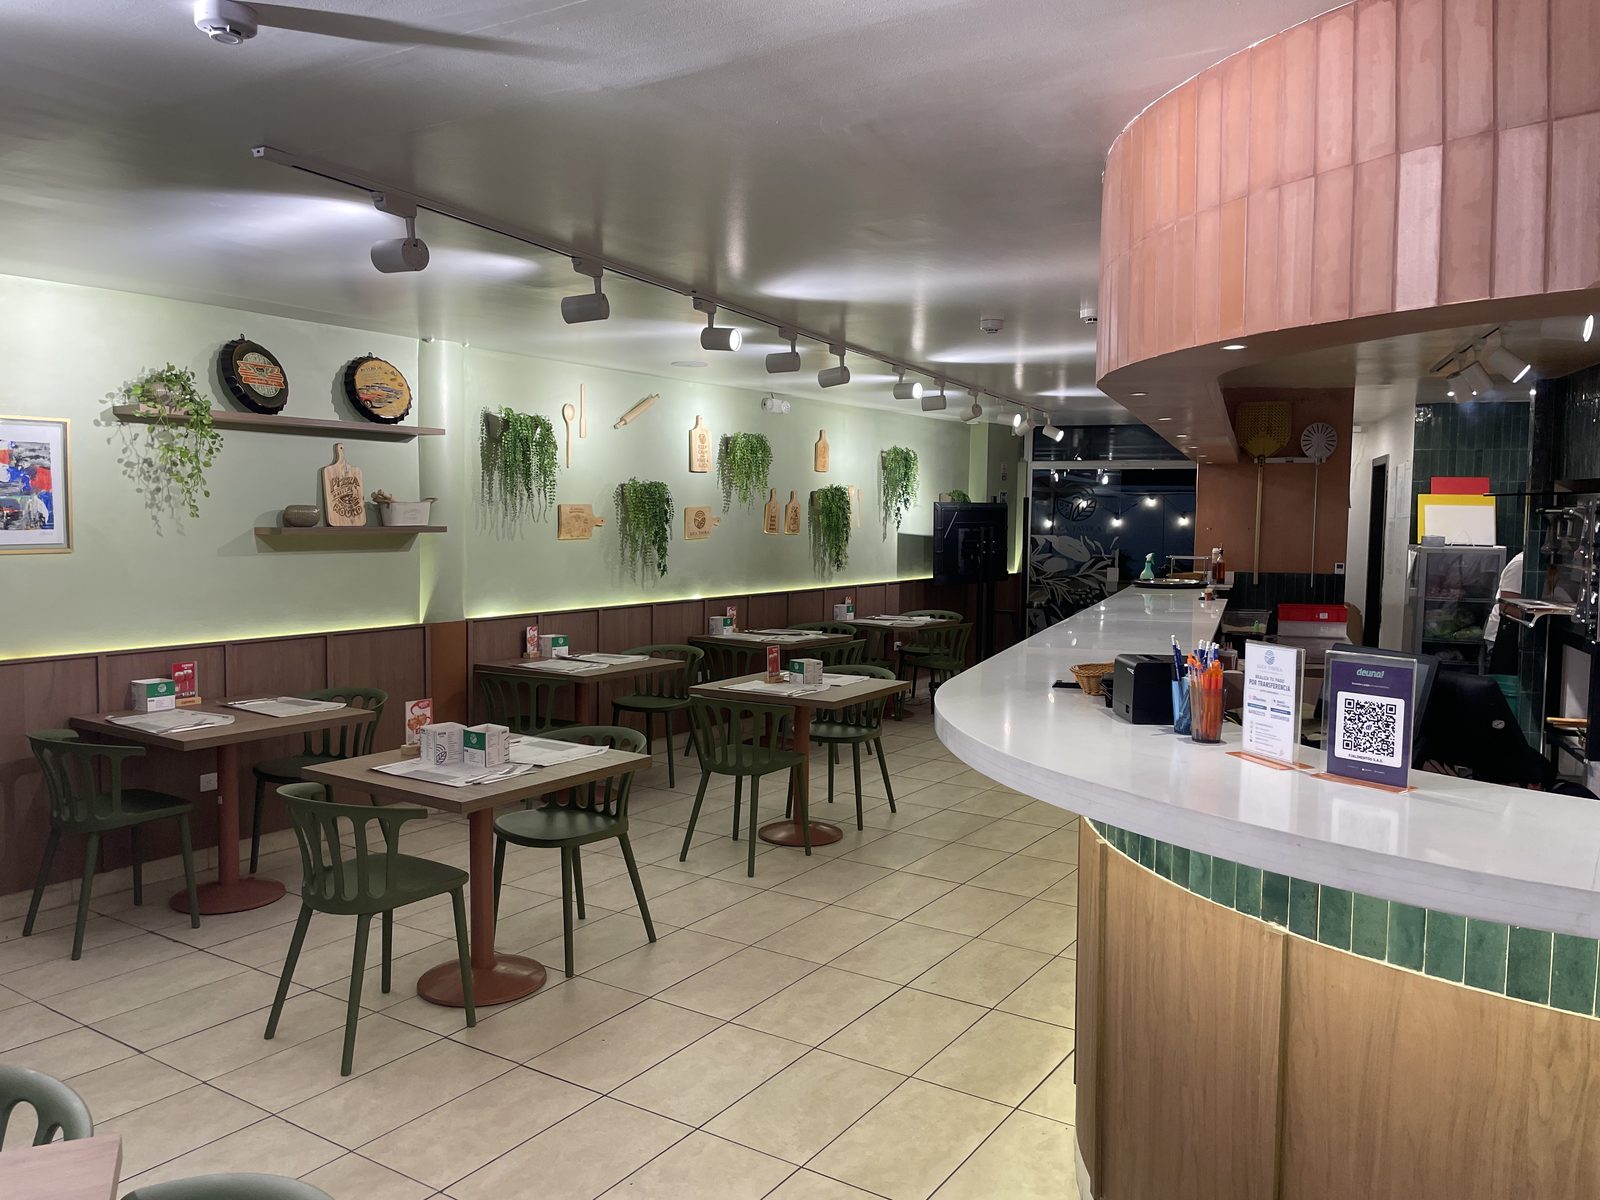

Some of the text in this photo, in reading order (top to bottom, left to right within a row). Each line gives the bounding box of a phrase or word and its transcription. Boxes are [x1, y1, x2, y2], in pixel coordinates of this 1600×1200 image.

[329, 476, 360, 493] PIZZA
[333, 503, 363, 517] ROUND
[1258, 680, 1291, 691] TRANSFERENCIA
